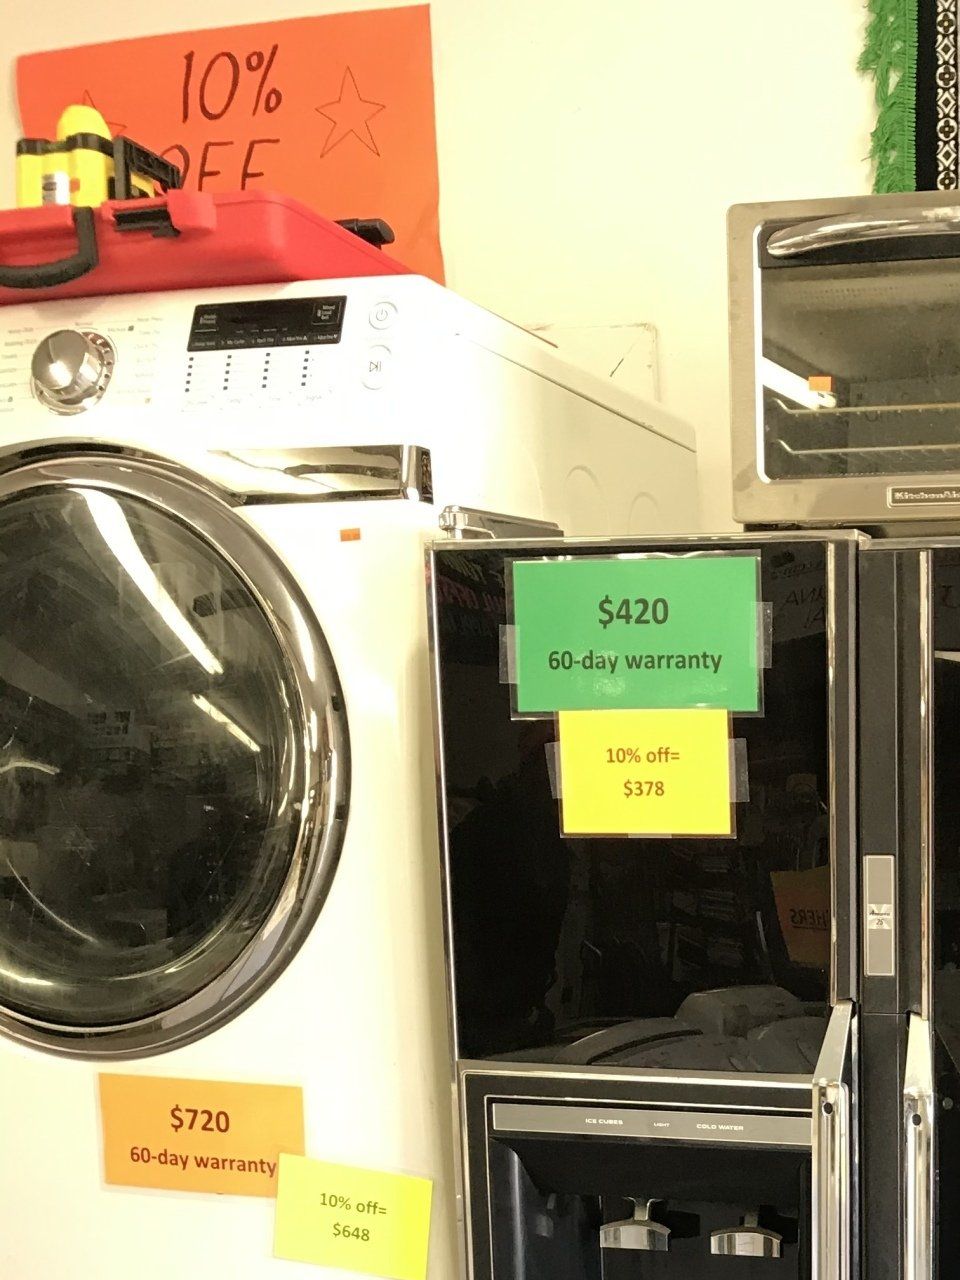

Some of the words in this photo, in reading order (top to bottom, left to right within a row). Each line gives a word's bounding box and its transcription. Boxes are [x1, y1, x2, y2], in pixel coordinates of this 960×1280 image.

[182, 43, 283, 124] 10%
[598, 594, 669, 630] $420
[547, 649, 619, 674] 60-day
[624, 650, 723, 674] warranty
[605, 747, 642, 764] 10%
[645, 746, 681, 764] off=
[622, 780, 665, 800] $378
[169, 1103, 231, 1134] $720
[598, 1118, 624, 1126] CUBES
[129, 1145, 189, 1171] 60-day
[193, 1153, 278, 1179] warranty
[319, 1192, 352, 1211] 10%
[356, 1199, 387, 1217] off=
[331, 1221, 370, 1243] $648
